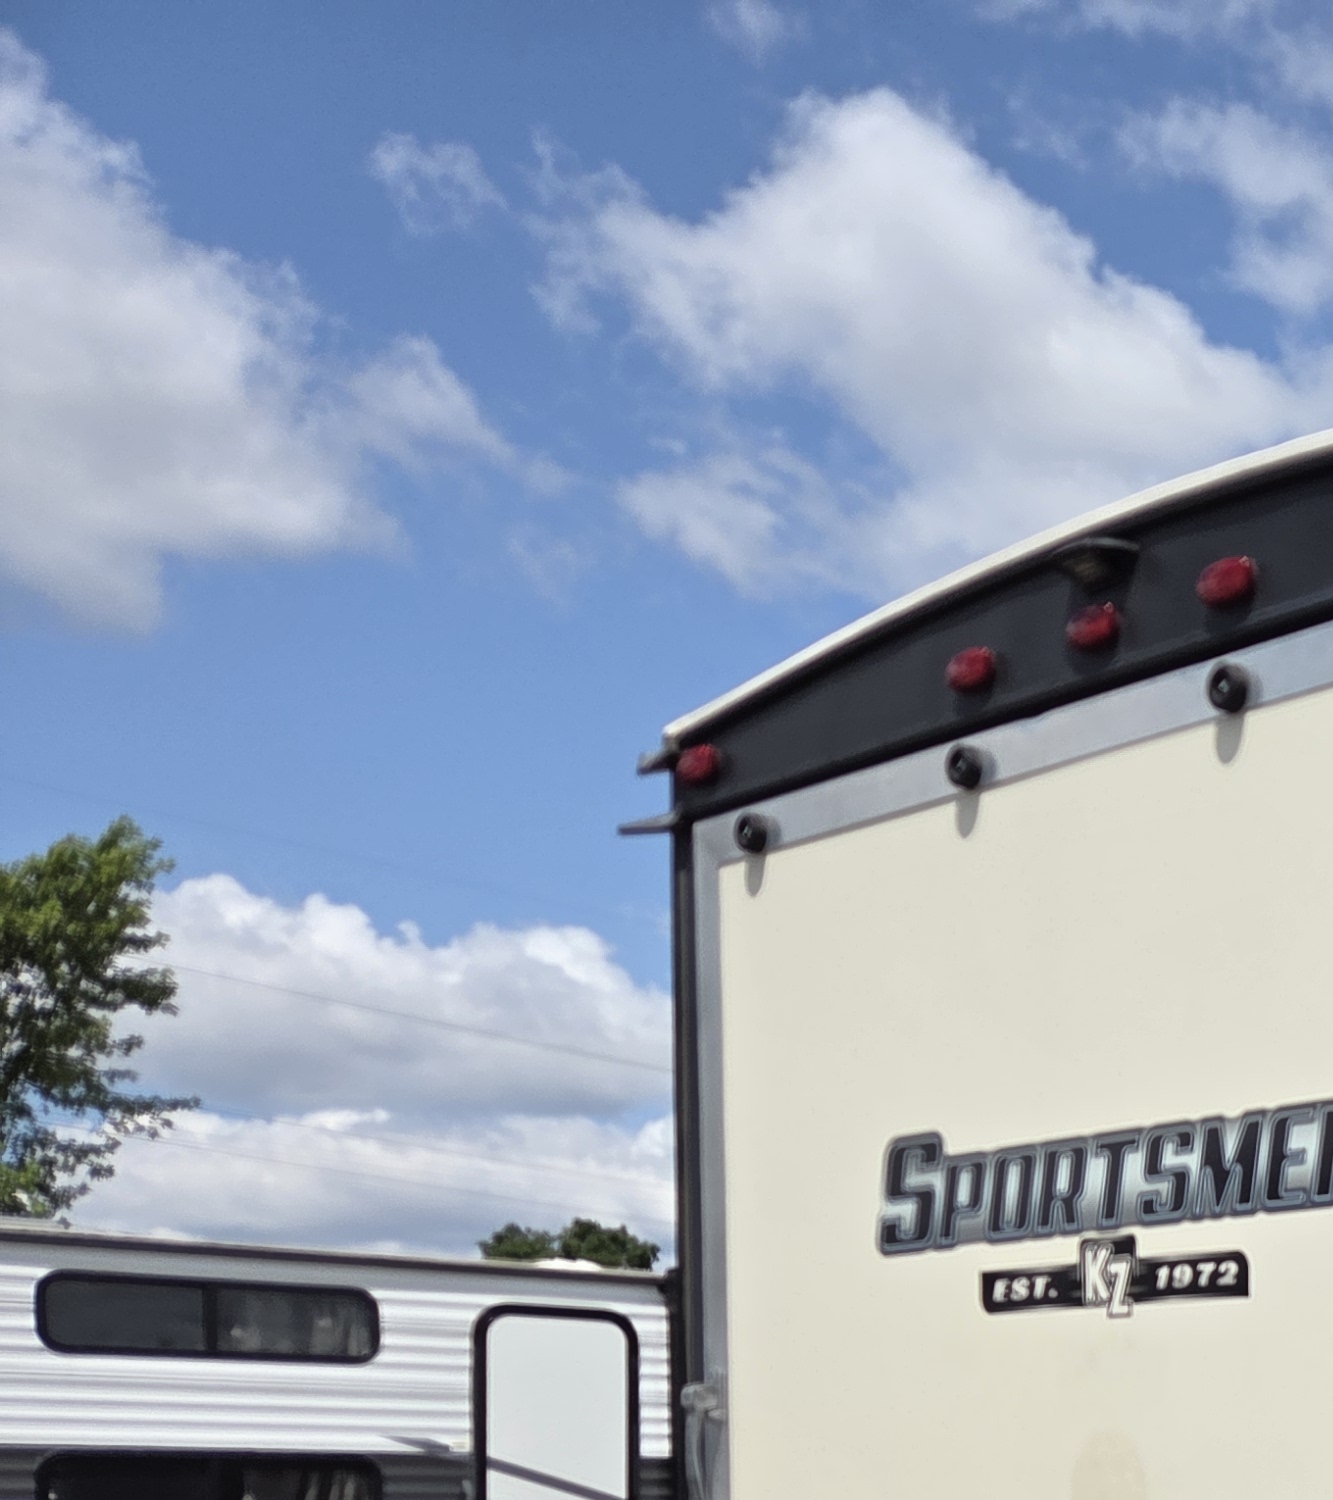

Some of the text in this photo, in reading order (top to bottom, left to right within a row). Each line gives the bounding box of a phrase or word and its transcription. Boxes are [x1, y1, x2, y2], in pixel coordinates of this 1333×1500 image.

[991, 1240, 1240, 1319] EST. KZ 1972
